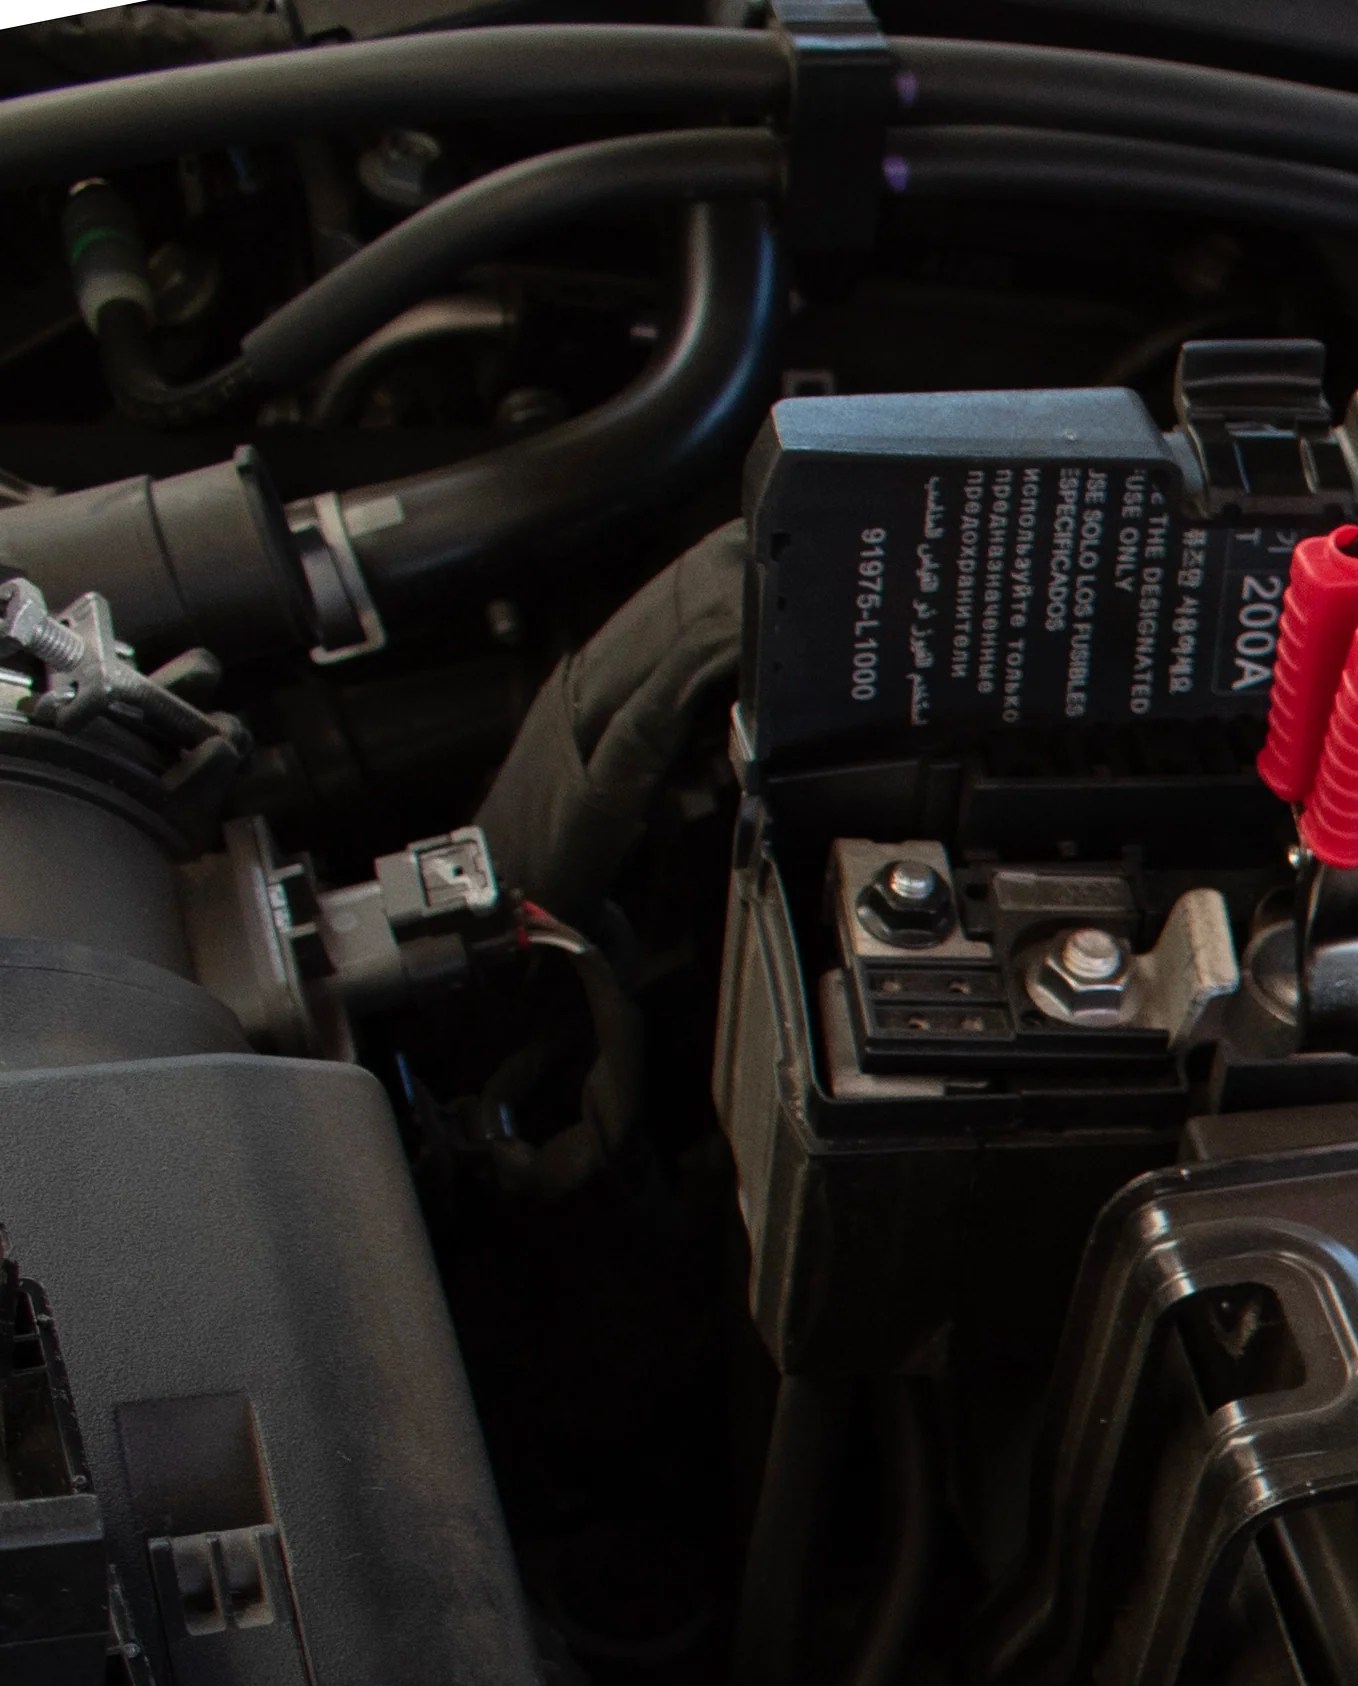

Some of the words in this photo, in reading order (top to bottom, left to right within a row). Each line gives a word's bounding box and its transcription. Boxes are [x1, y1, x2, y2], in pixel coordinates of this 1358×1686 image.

[950, 470, 985, 678] предохранители
[976, 469, 1014, 694] предназначенные
[1009, 468, 1041, 628] используйте
[1044, 468, 1082, 632] ESPECIFICADOS
[1077, 509, 1104, 570] SOLO
[1113, 527, 1141, 592] ONLY
[1144, 512, 1170, 559] THE
[850, 527, 888, 700] 91975-L1000
[1072, 574, 1097, 618] LOS
[1129, 567, 1165, 714] DESIGNATED
[1232, 576, 1282, 690] 200A
[1002, 638, 1026, 723] только
[1063, 622, 1094, 717] FUSIBLES
